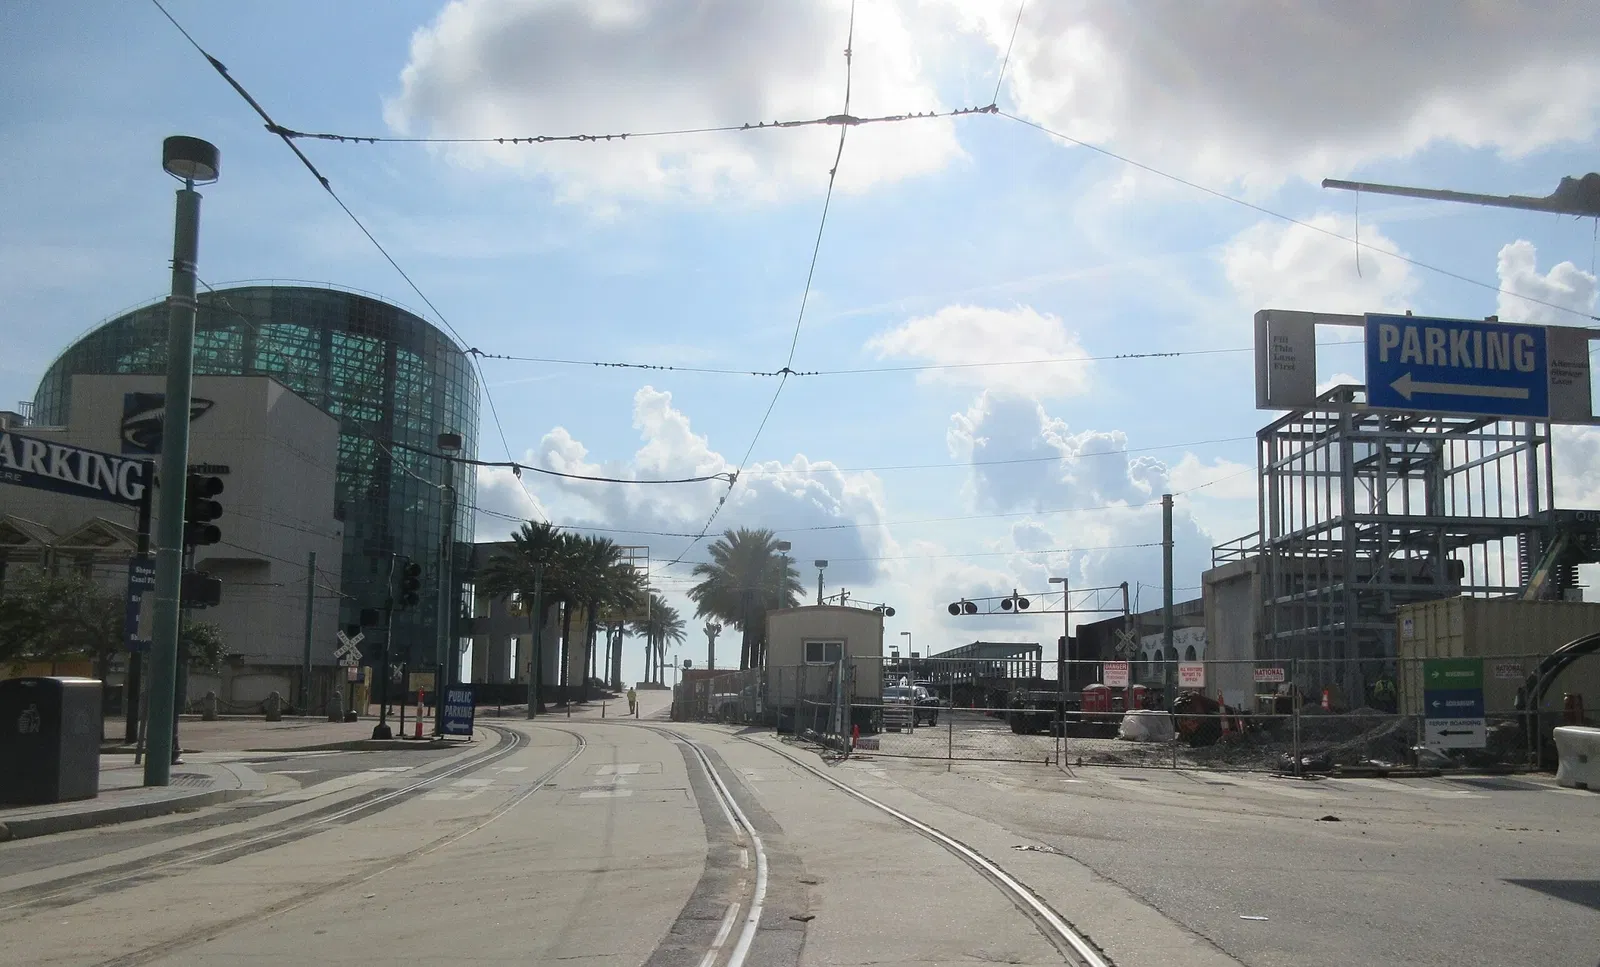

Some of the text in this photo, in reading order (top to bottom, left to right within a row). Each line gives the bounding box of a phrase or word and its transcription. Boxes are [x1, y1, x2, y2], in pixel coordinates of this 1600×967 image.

[1378, 323, 1536, 373] PARKING
[448, 690, 472, 703] PUBLIC
[444, 705, 473, 718] PARKING
